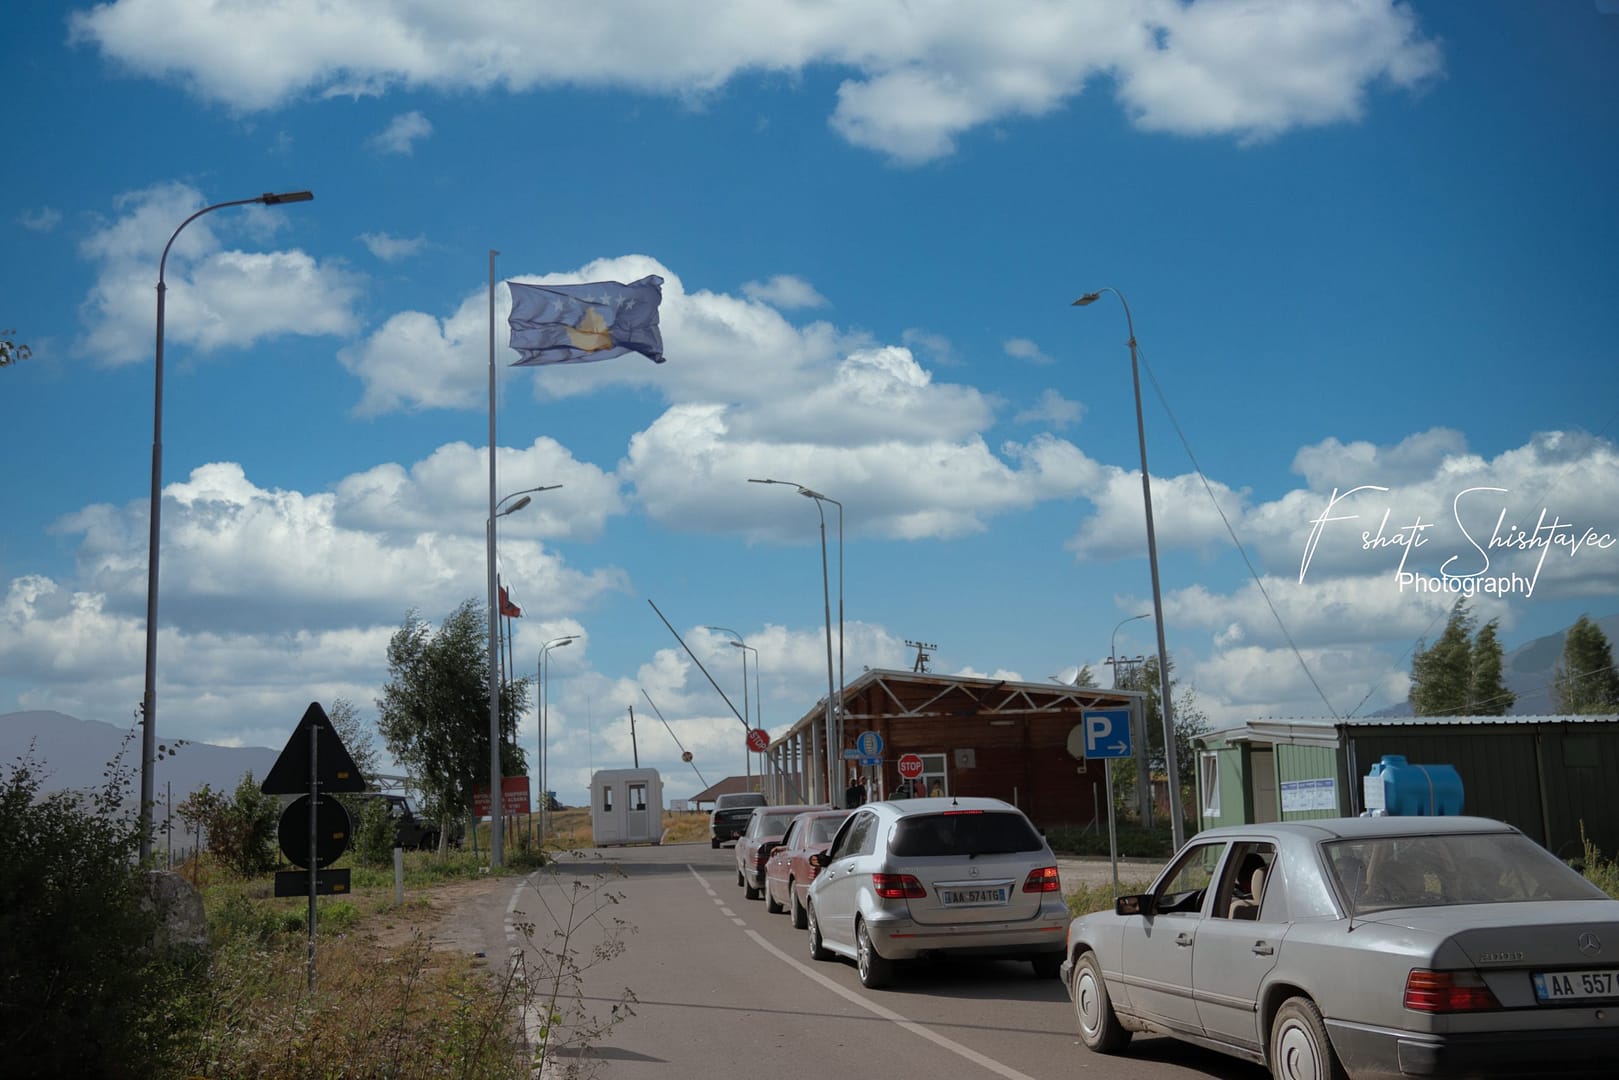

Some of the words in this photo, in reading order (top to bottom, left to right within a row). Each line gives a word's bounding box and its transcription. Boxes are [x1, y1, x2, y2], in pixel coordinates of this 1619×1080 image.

[750, 731, 768, 751] STOP
[1086, 716, 1113, 751] P
[900, 761, 921, 772] STOP
[952, 891, 965, 904] AA
[1551, 975, 1575, 996] AA
[1581, 973, 1612, 994] 557
